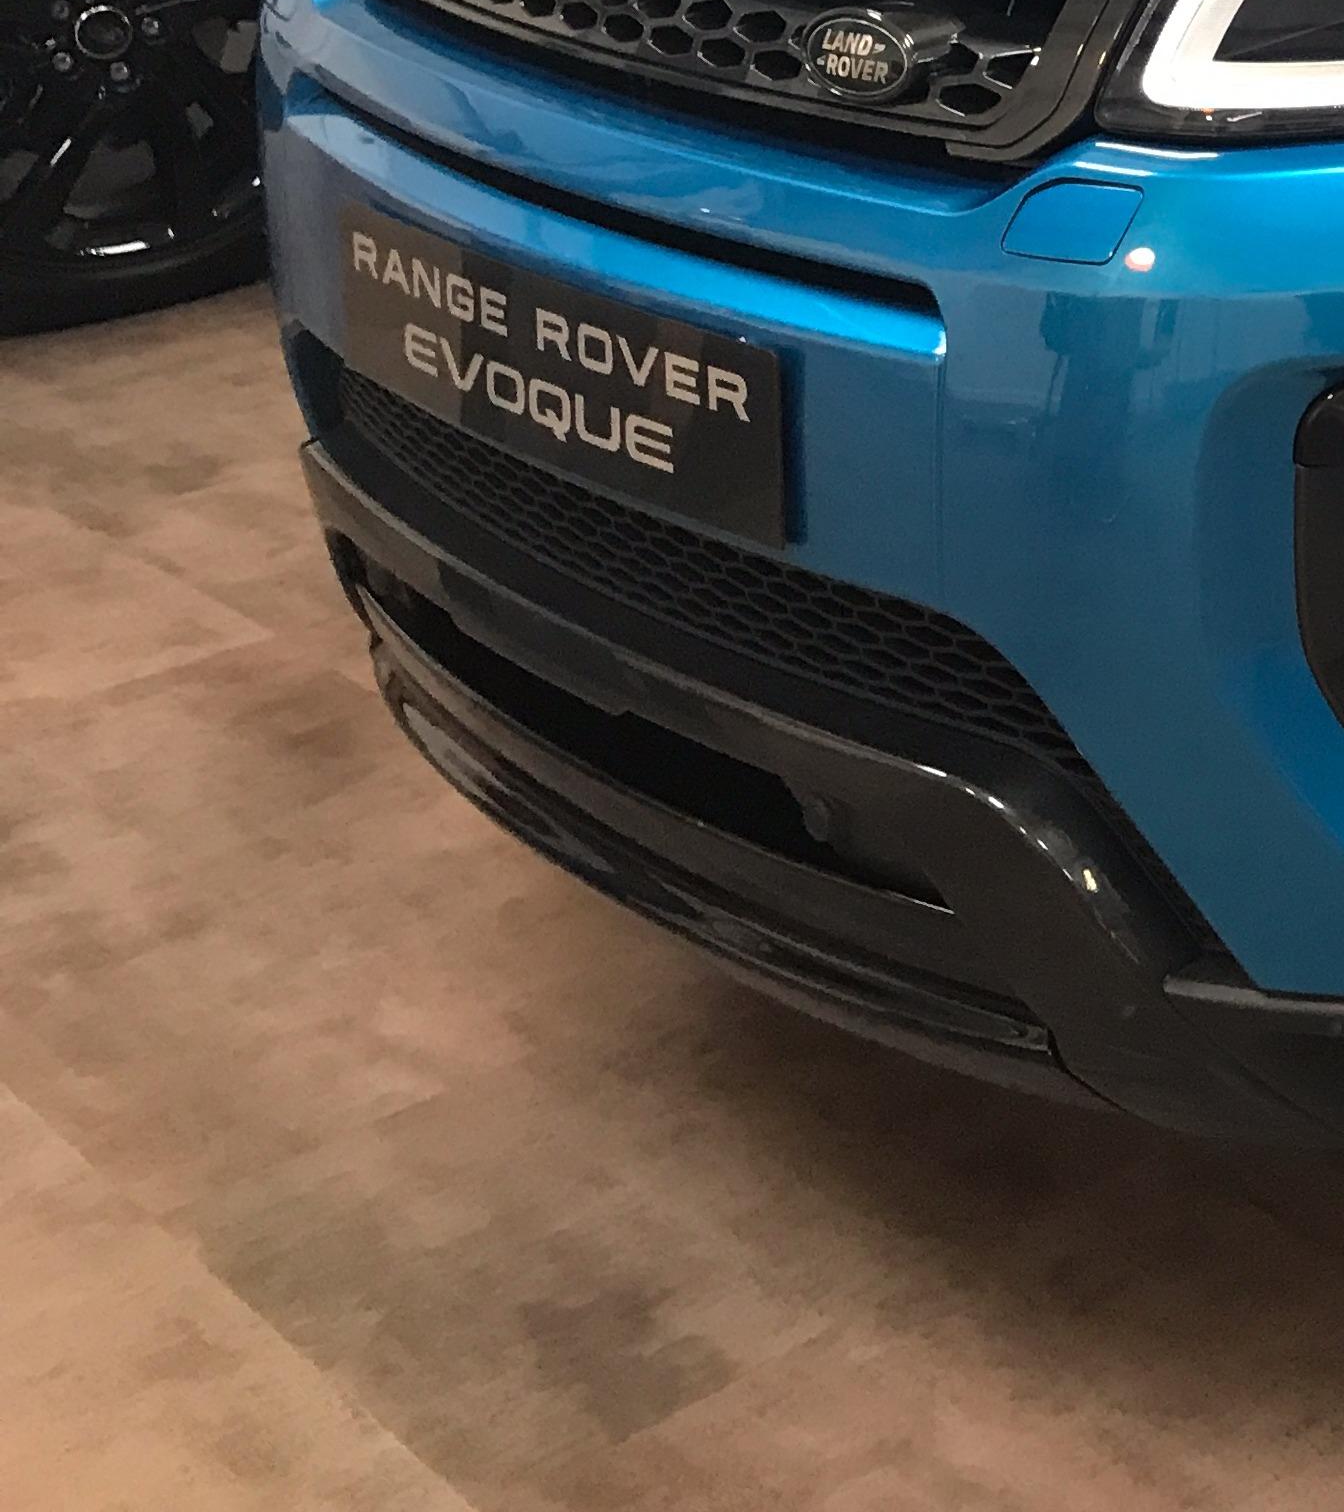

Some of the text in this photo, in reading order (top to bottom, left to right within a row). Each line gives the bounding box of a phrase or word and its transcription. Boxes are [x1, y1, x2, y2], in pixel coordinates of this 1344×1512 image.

[821, 28, 874, 56] LAND
[825, 53, 889, 85] ROVER
[351, 231, 751, 423] RANGE ROVER
[403, 323, 675, 474] EVOQUE
